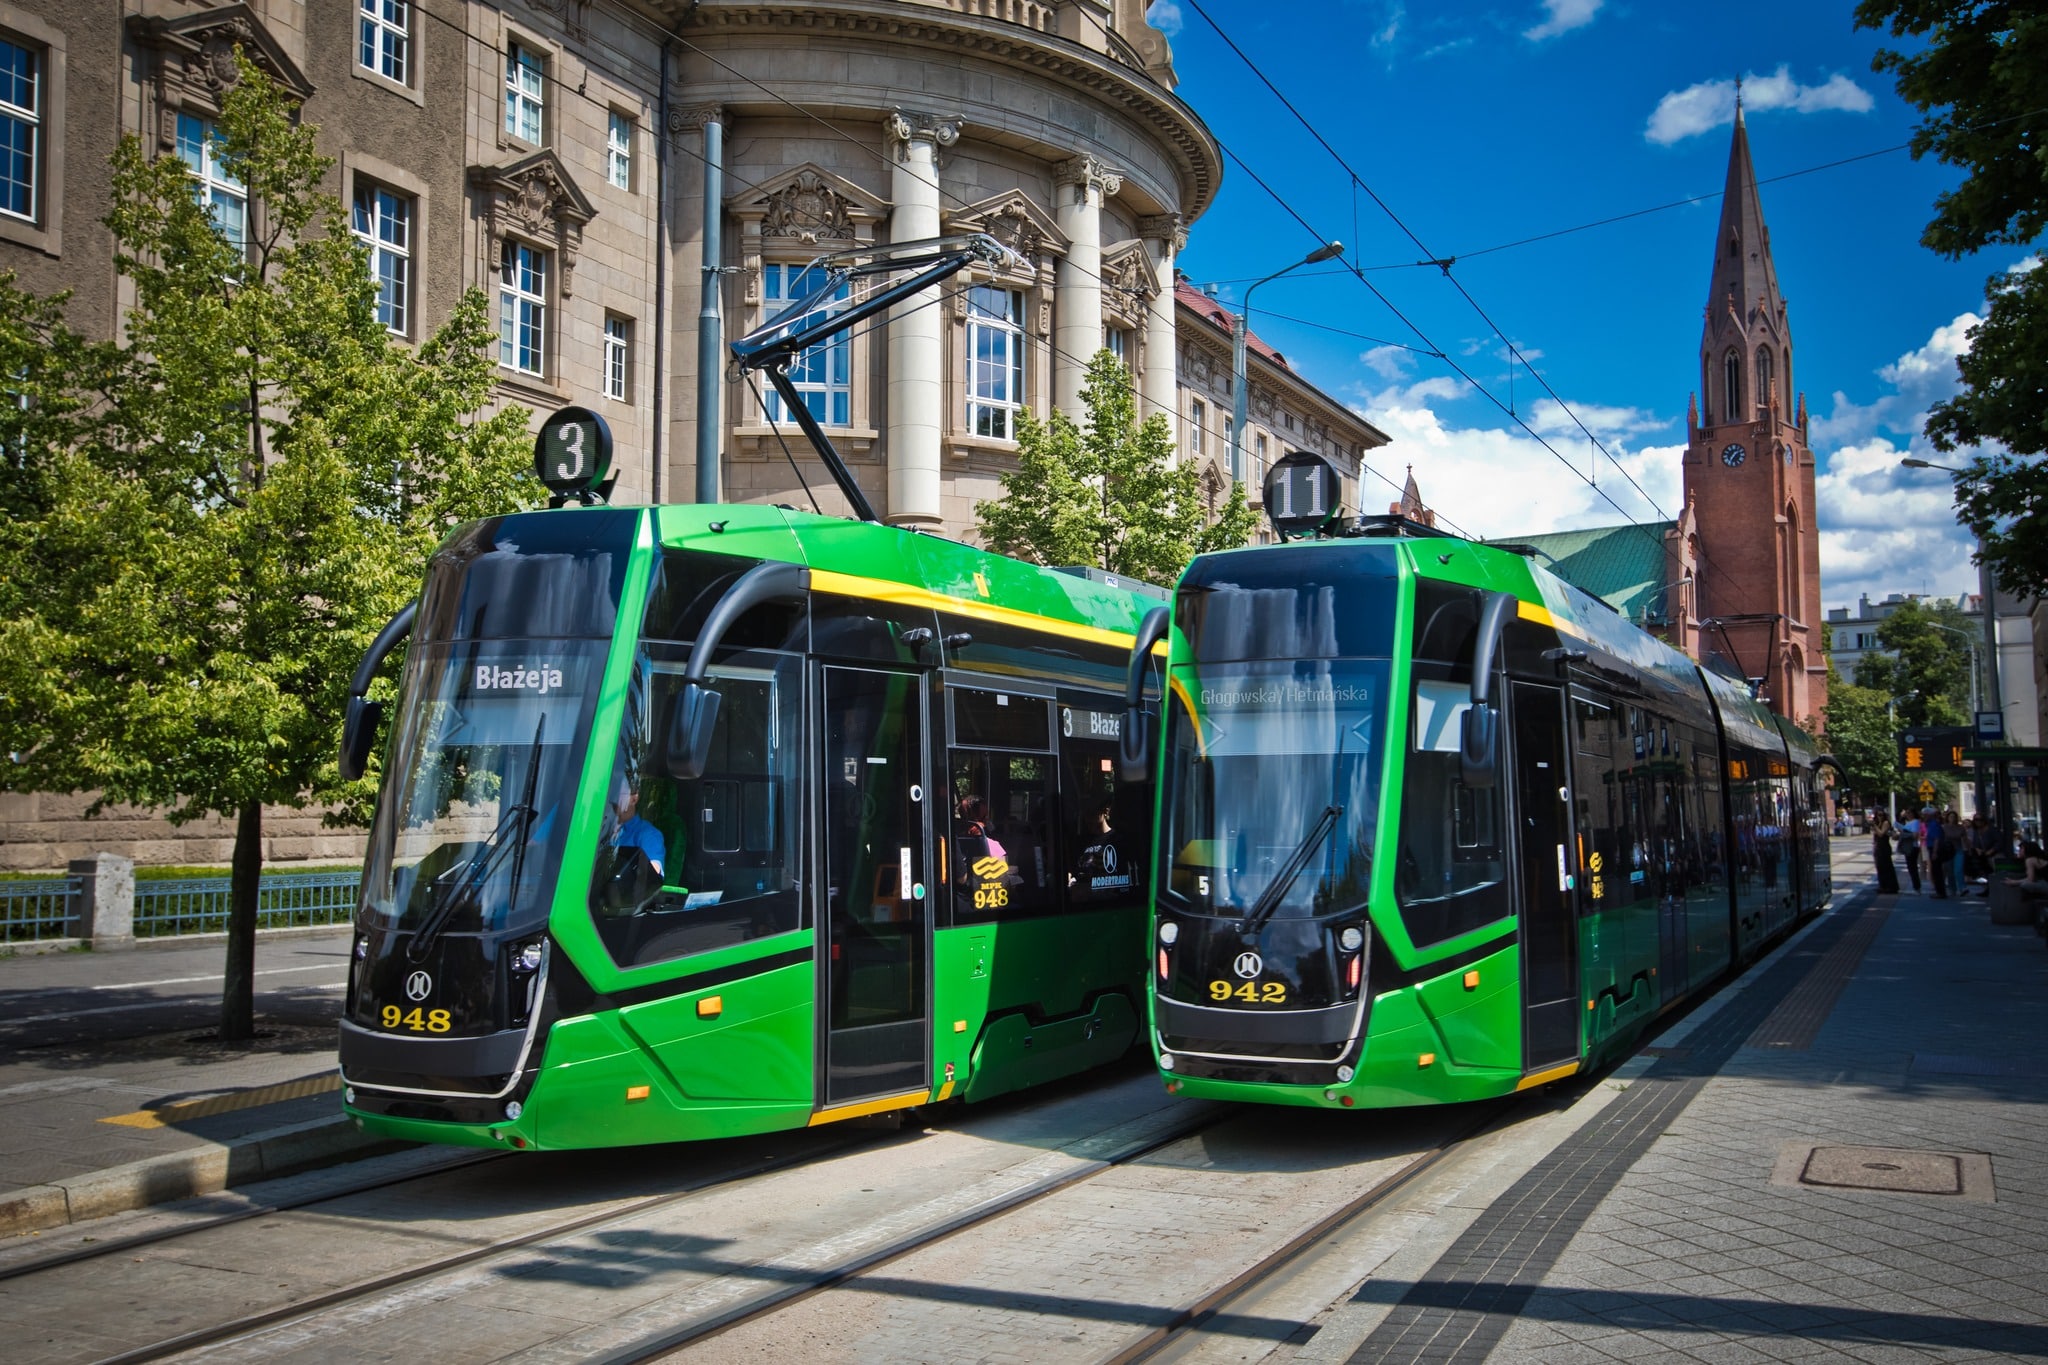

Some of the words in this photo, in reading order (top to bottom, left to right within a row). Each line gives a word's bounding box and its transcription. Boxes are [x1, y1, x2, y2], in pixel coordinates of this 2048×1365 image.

[558, 422, 584, 480] 3
[1277, 464, 1326, 519] 11
[476, 663, 563, 695] Błażeja
[1063, 707, 1073, 738] 3
[974, 888, 1009, 909] 948
[1198, 875, 1210, 896] 5
[1208, 980, 1287, 1004] 942
[382, 1005, 451, 1033] 948
